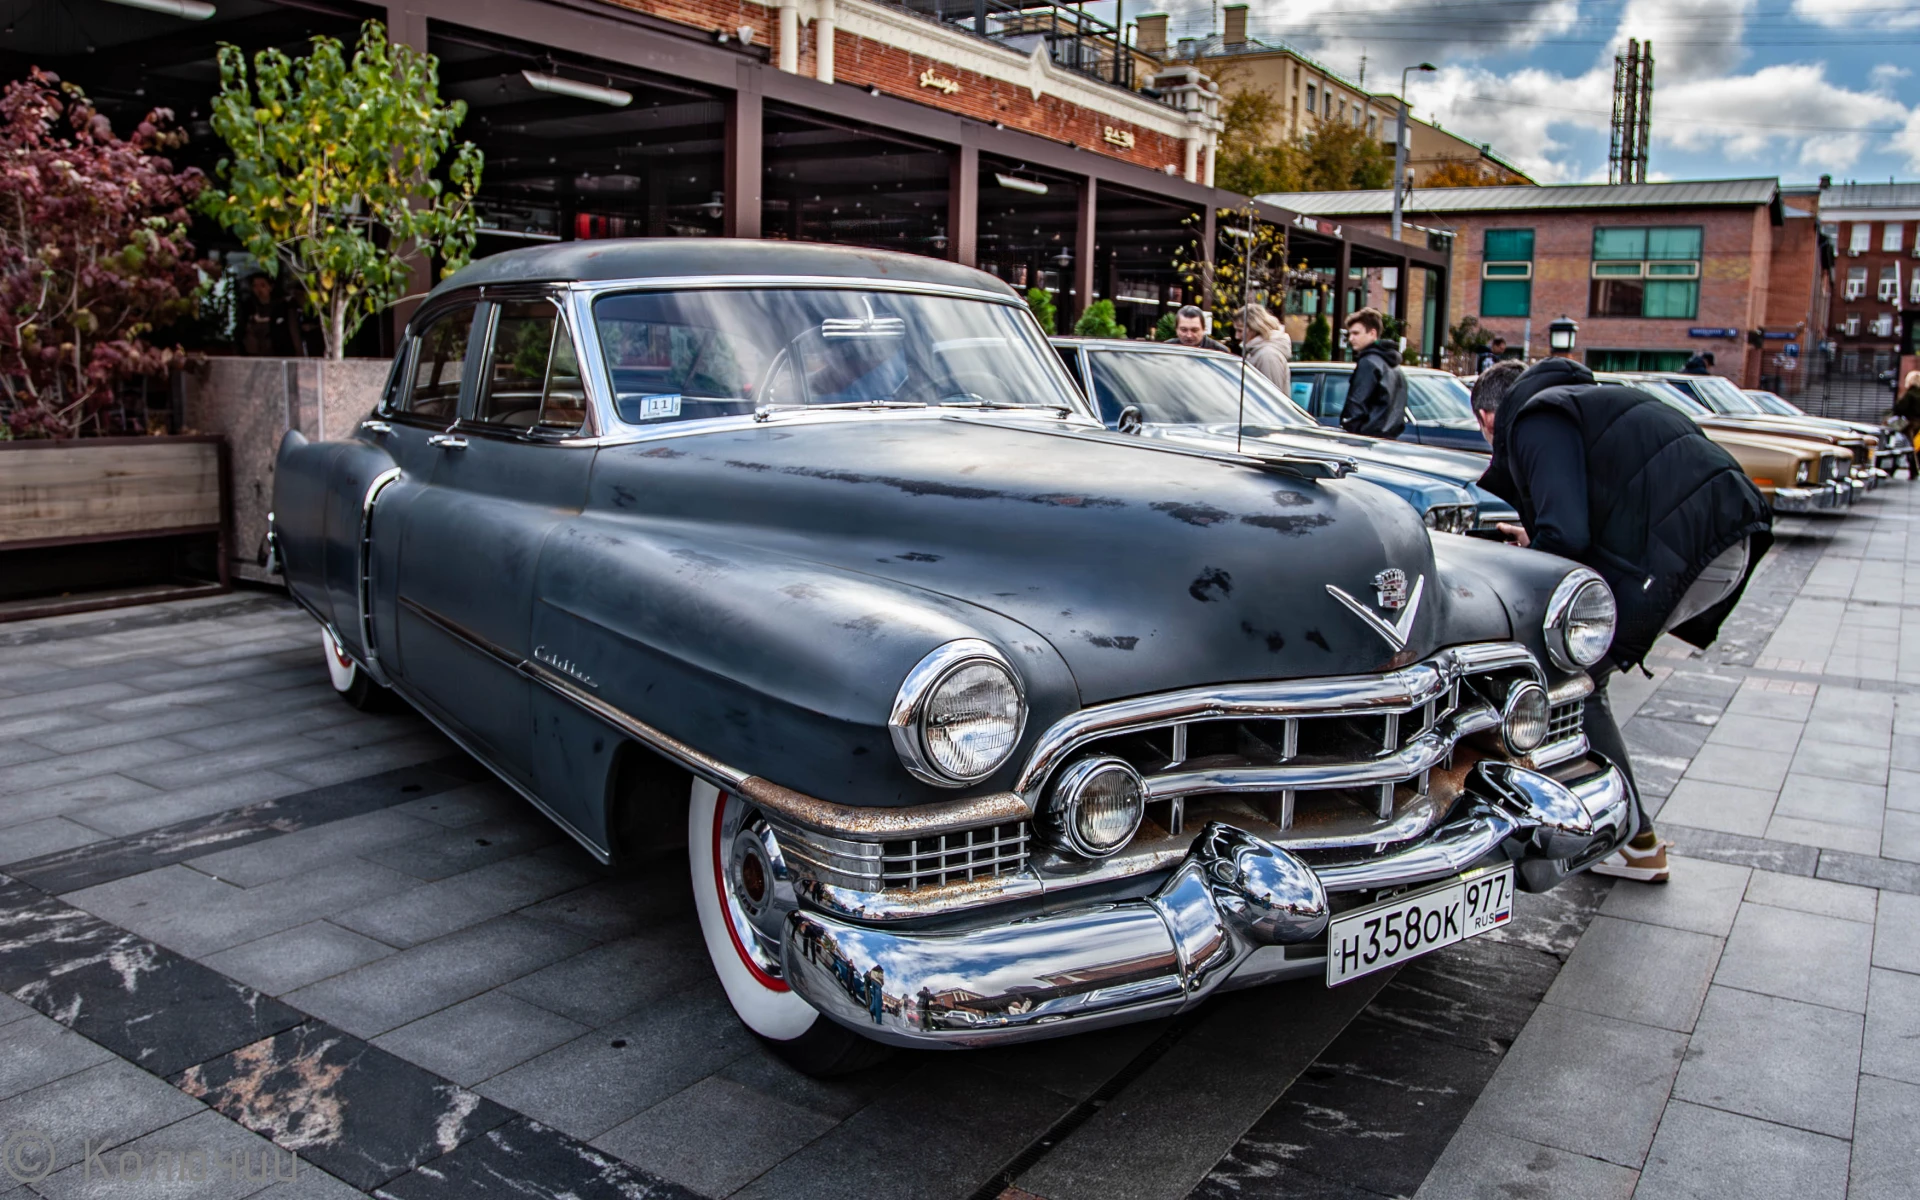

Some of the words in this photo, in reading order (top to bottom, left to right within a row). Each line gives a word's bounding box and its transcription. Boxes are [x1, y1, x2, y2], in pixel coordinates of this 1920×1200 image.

[652, 400, 668, 410] 11
[534, 644, 599, 688] Cadillac
[1467, 874, 1507, 918] 977
[1474, 912, 1495, 929] RUS
